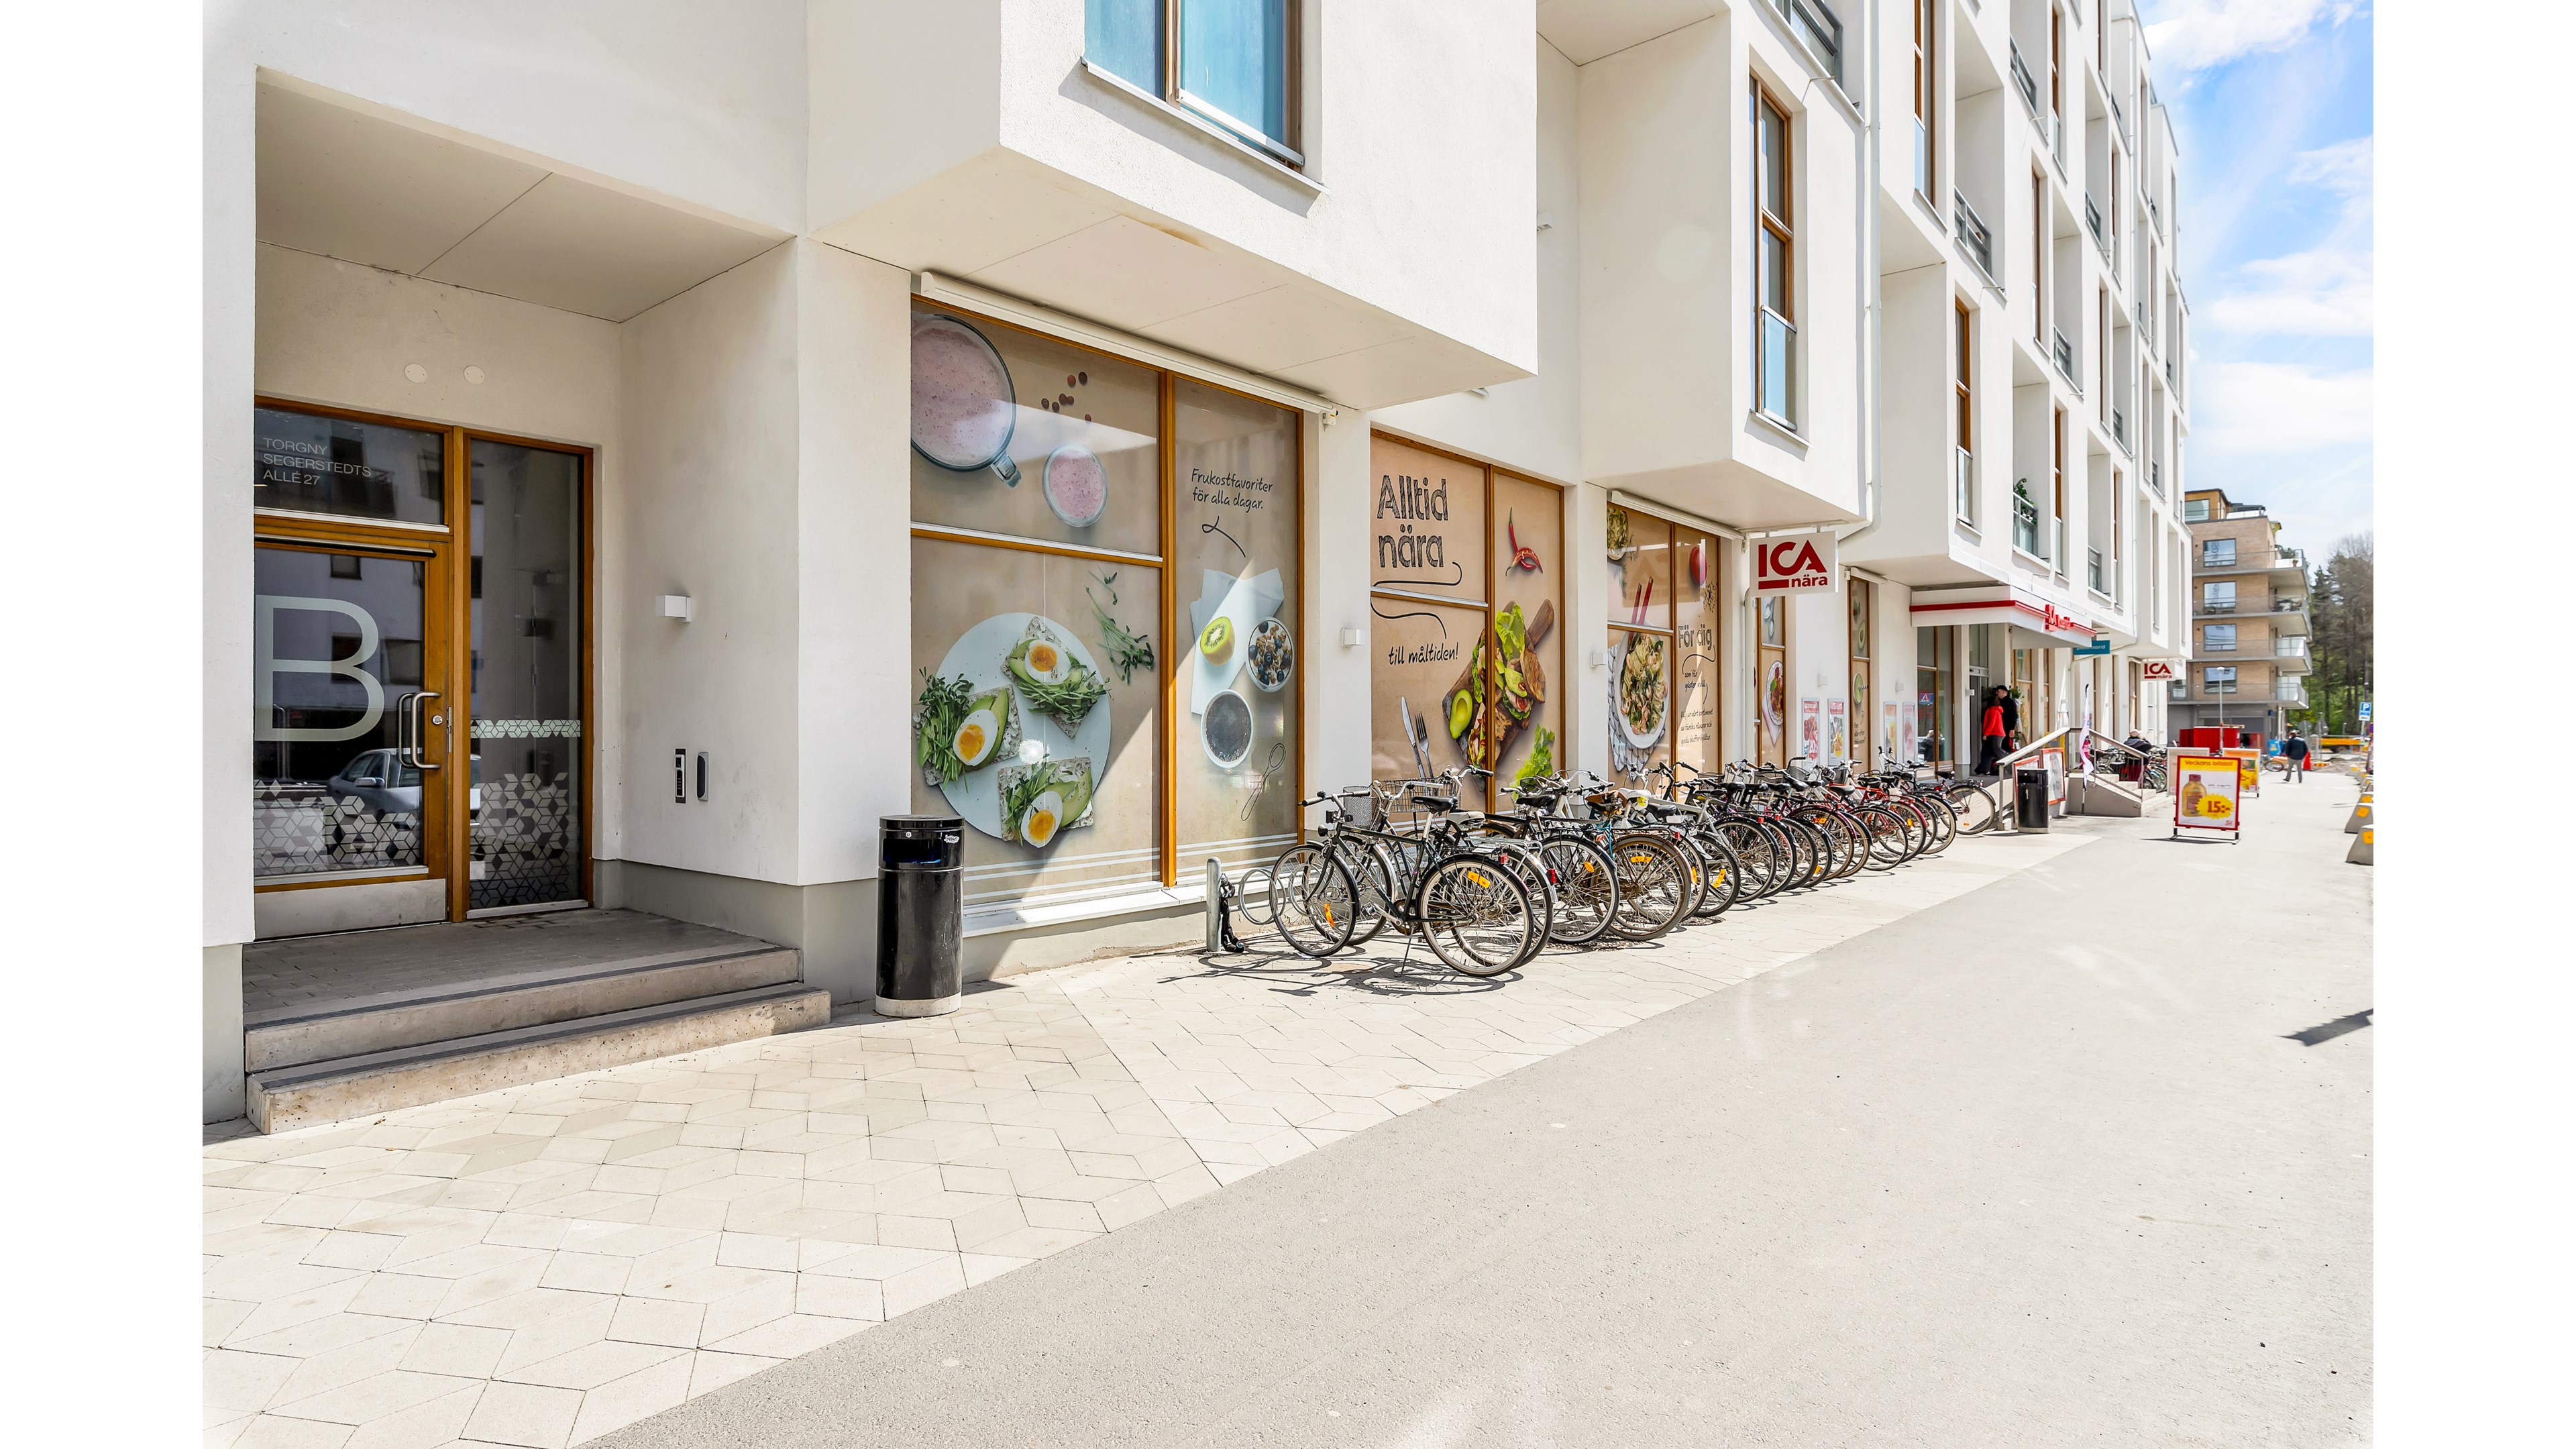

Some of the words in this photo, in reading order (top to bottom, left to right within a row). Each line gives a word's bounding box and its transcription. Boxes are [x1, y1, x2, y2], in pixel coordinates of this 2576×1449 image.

[263, 437, 327, 455] TORGNY
[263, 453, 372, 477] SEGERSTEDTS
[263, 470, 301, 484] ALLÉ
[303, 474, 321, 485] 27
[1191, 468, 1273, 492] Frukostfavoriter
[1192, 486, 1210, 502] för
[1211, 490, 1230, 506] alla
[1233, 492, 1263, 513] dagar.
[1377, 474, 1449, 521] Alltid
[1378, 524, 1444, 568] nära
[1758, 539, 1827, 578] ICA
[1791, 574, 1828, 588] nära
[1678, 624, 1695, 649] För
[1697, 623, 1712, 651] dig
[1388, 645, 1405, 665] till
[1408, 641, 1459, 664] måltiden!
[254, 594, 385, 742] B
[2144, 663, 2171, 675] ICA
[2363, 703, 2369, 711] P
[2208, 800, 2231, 814] 15:-
